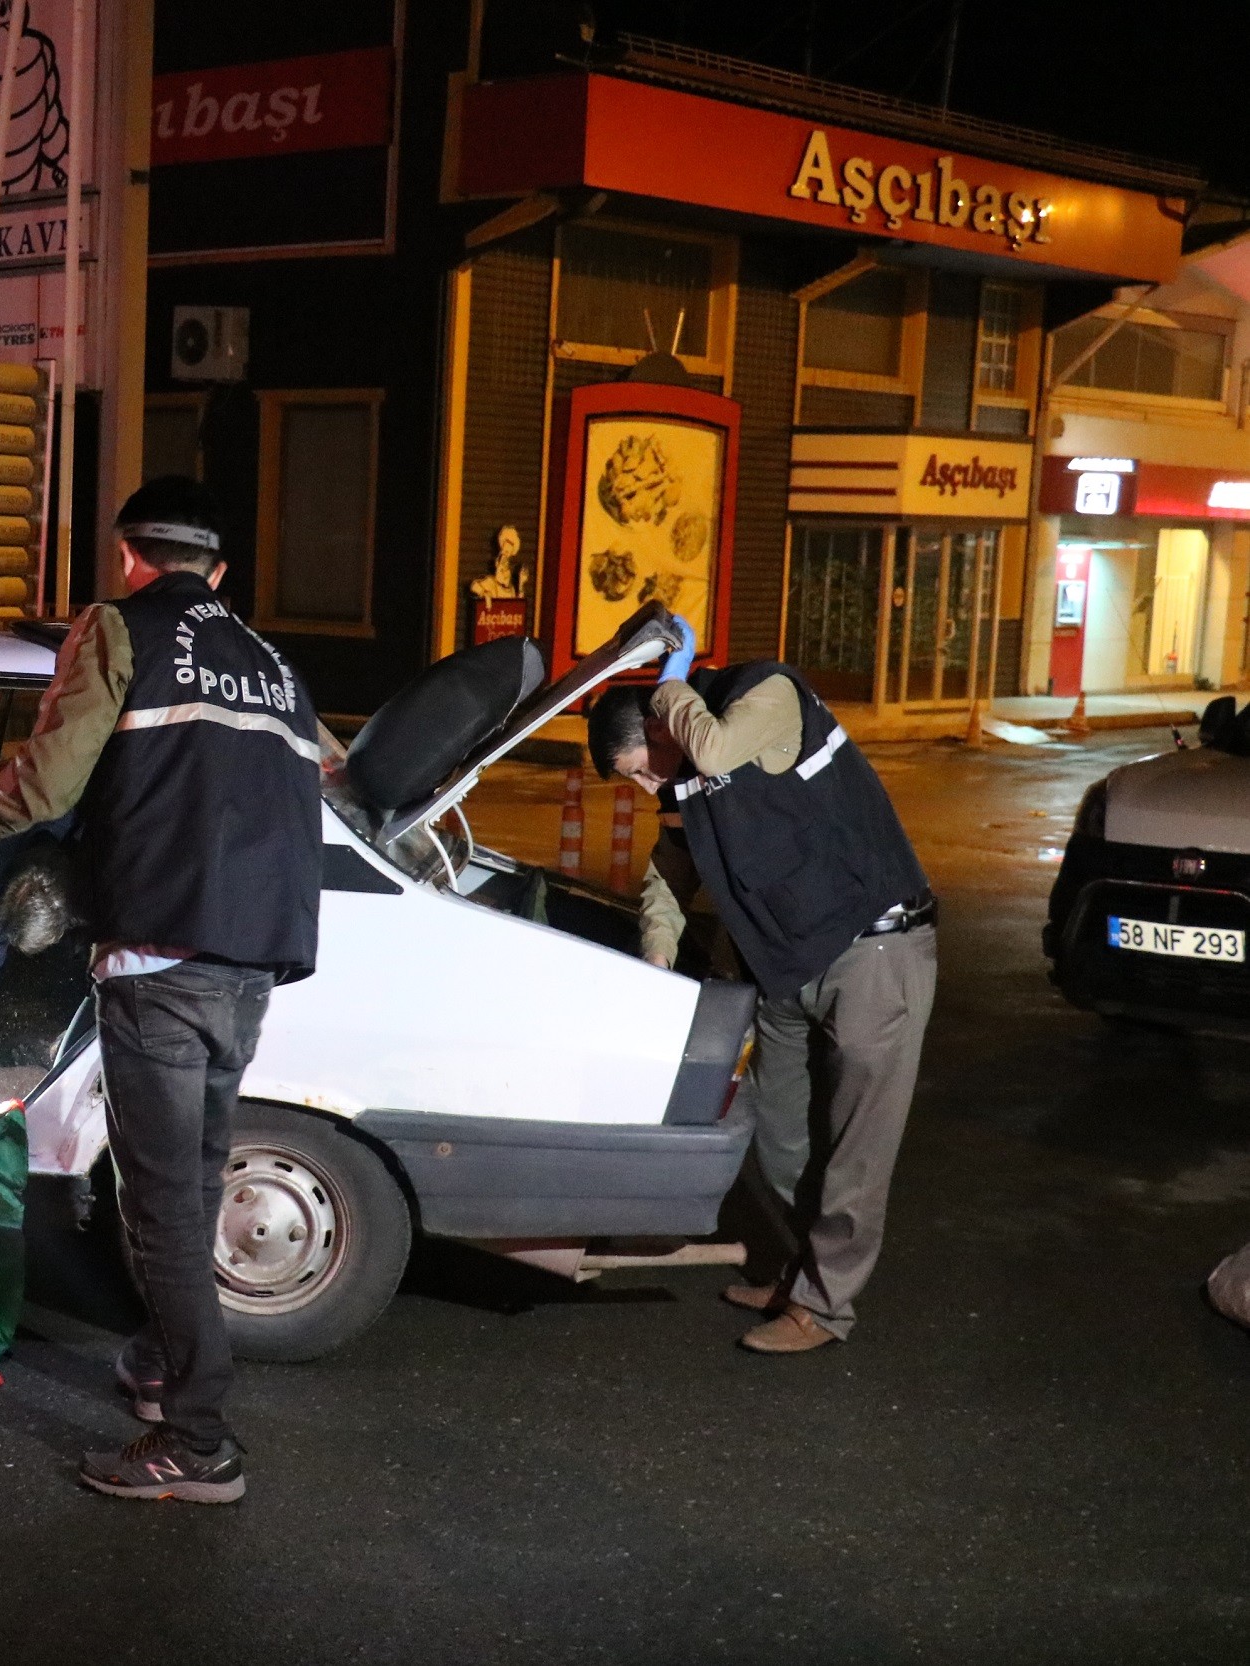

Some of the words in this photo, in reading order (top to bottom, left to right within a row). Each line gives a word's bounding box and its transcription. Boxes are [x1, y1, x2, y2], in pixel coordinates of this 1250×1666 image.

[155, 81, 325, 143] ıbaşı
[790, 129, 1054, 252] Aşçıbaşı
[919, 453, 1018, 498] Aşçıbaşı
[173, 621, 196, 684] OLAY
[199, 667, 287, 712] POLİS
[1120, 922, 1144, 947] 58
[1153, 926, 1185, 951] NF
[1192, 932, 1238, 957] 293
